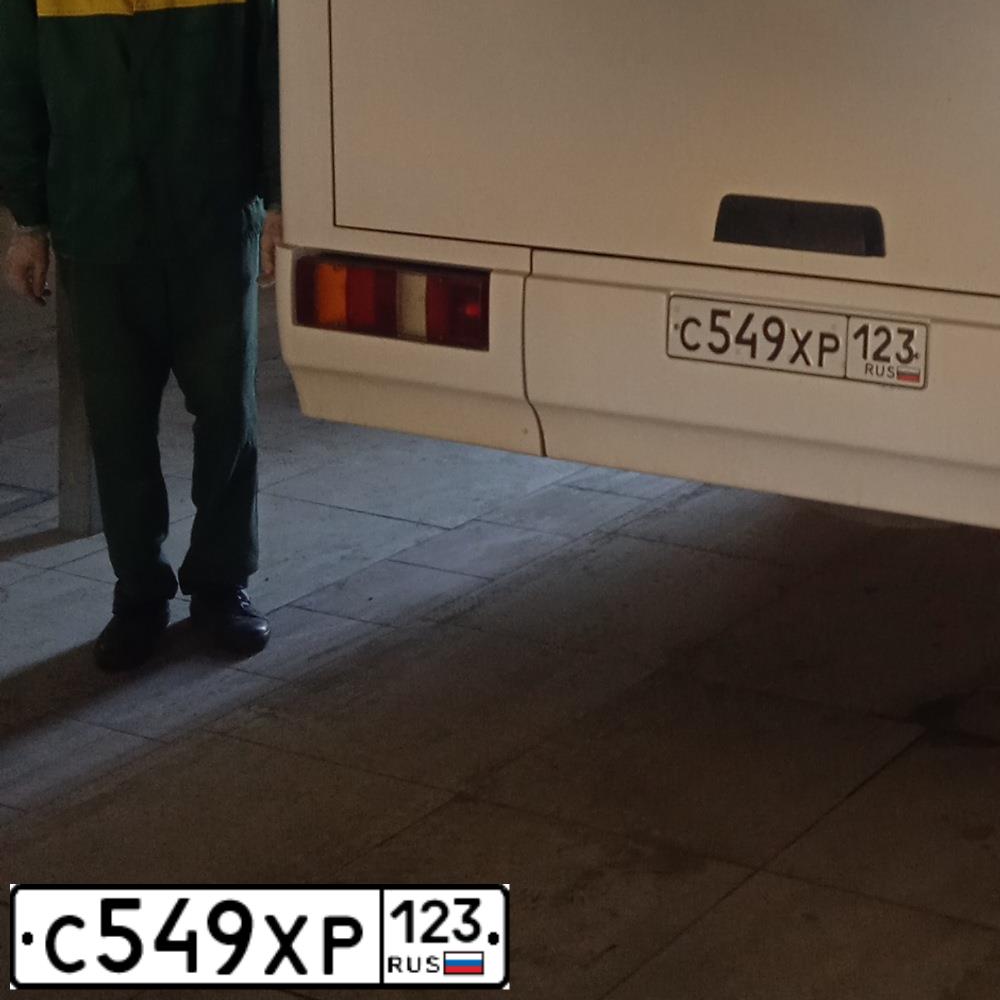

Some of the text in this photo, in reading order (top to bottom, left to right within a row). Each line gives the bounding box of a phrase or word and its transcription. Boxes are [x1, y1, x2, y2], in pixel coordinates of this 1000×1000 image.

[679, 308, 916, 368] С549ХР 123
[864, 363, 895, 378] RUS
